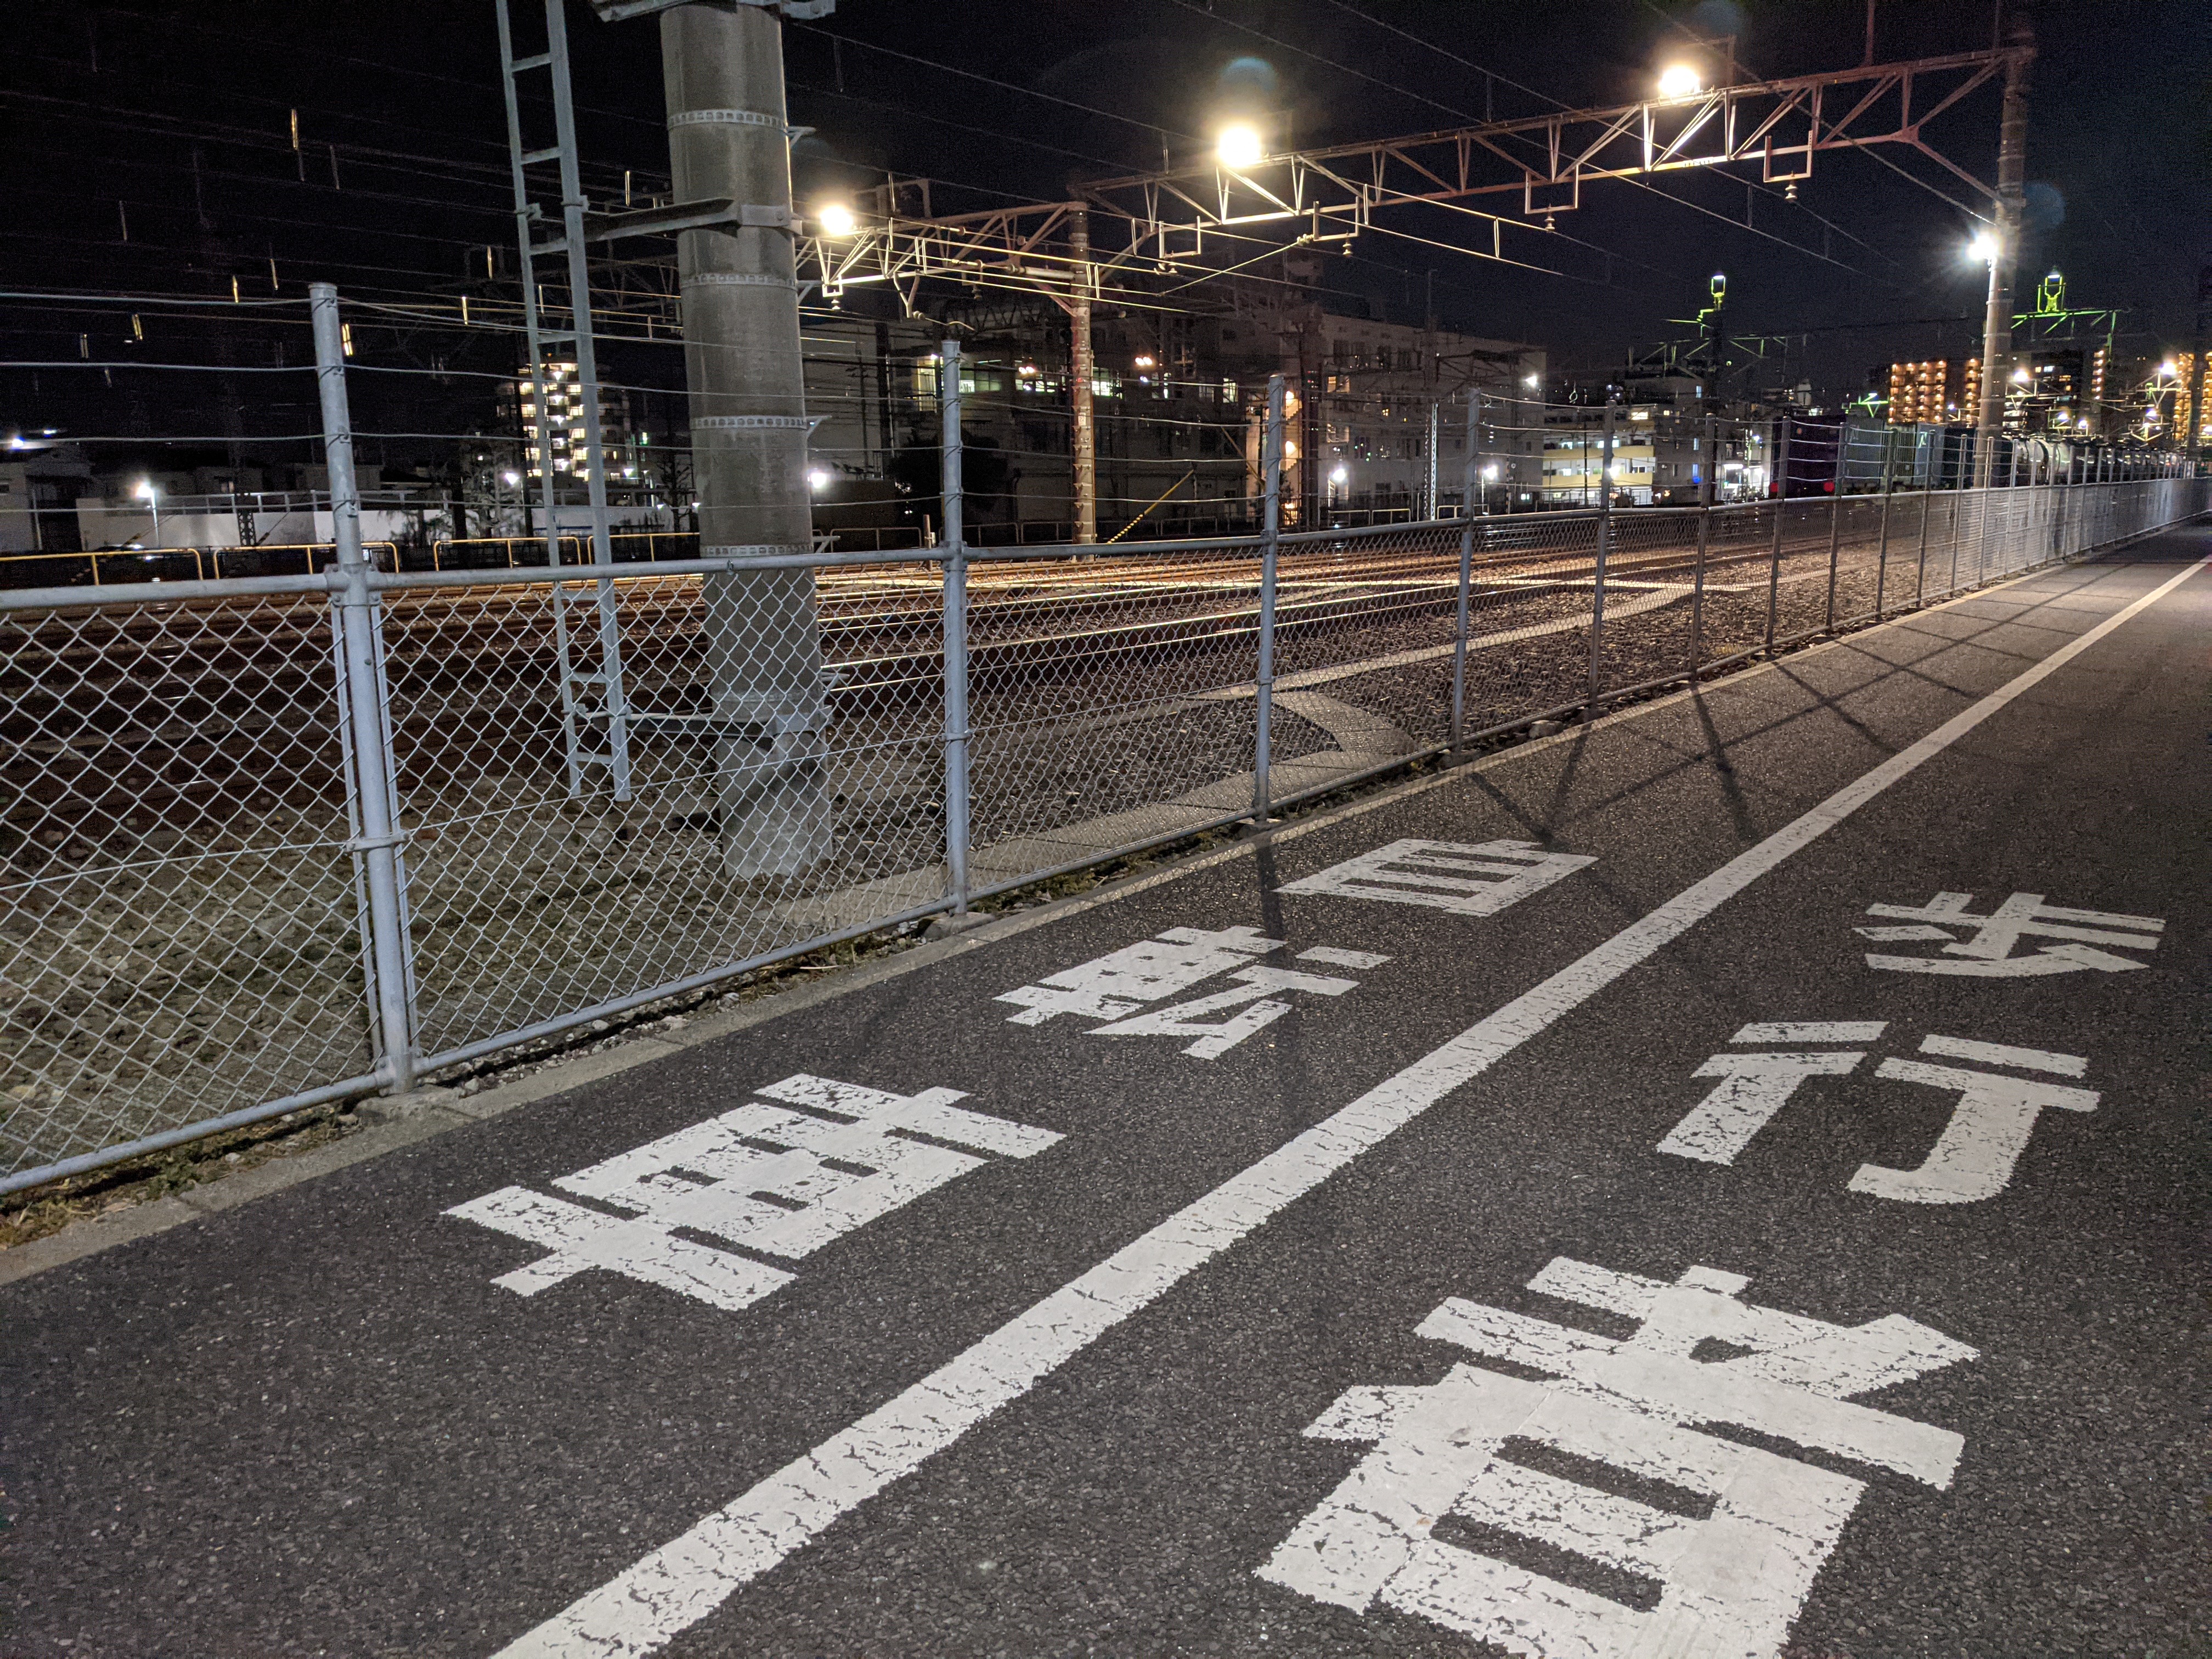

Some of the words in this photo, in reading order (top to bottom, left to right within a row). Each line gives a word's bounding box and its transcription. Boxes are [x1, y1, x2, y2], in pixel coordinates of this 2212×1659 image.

[444, 837, 1598, 1312] 自転車
[1252, 891, 2167, 1659] 歩行者
